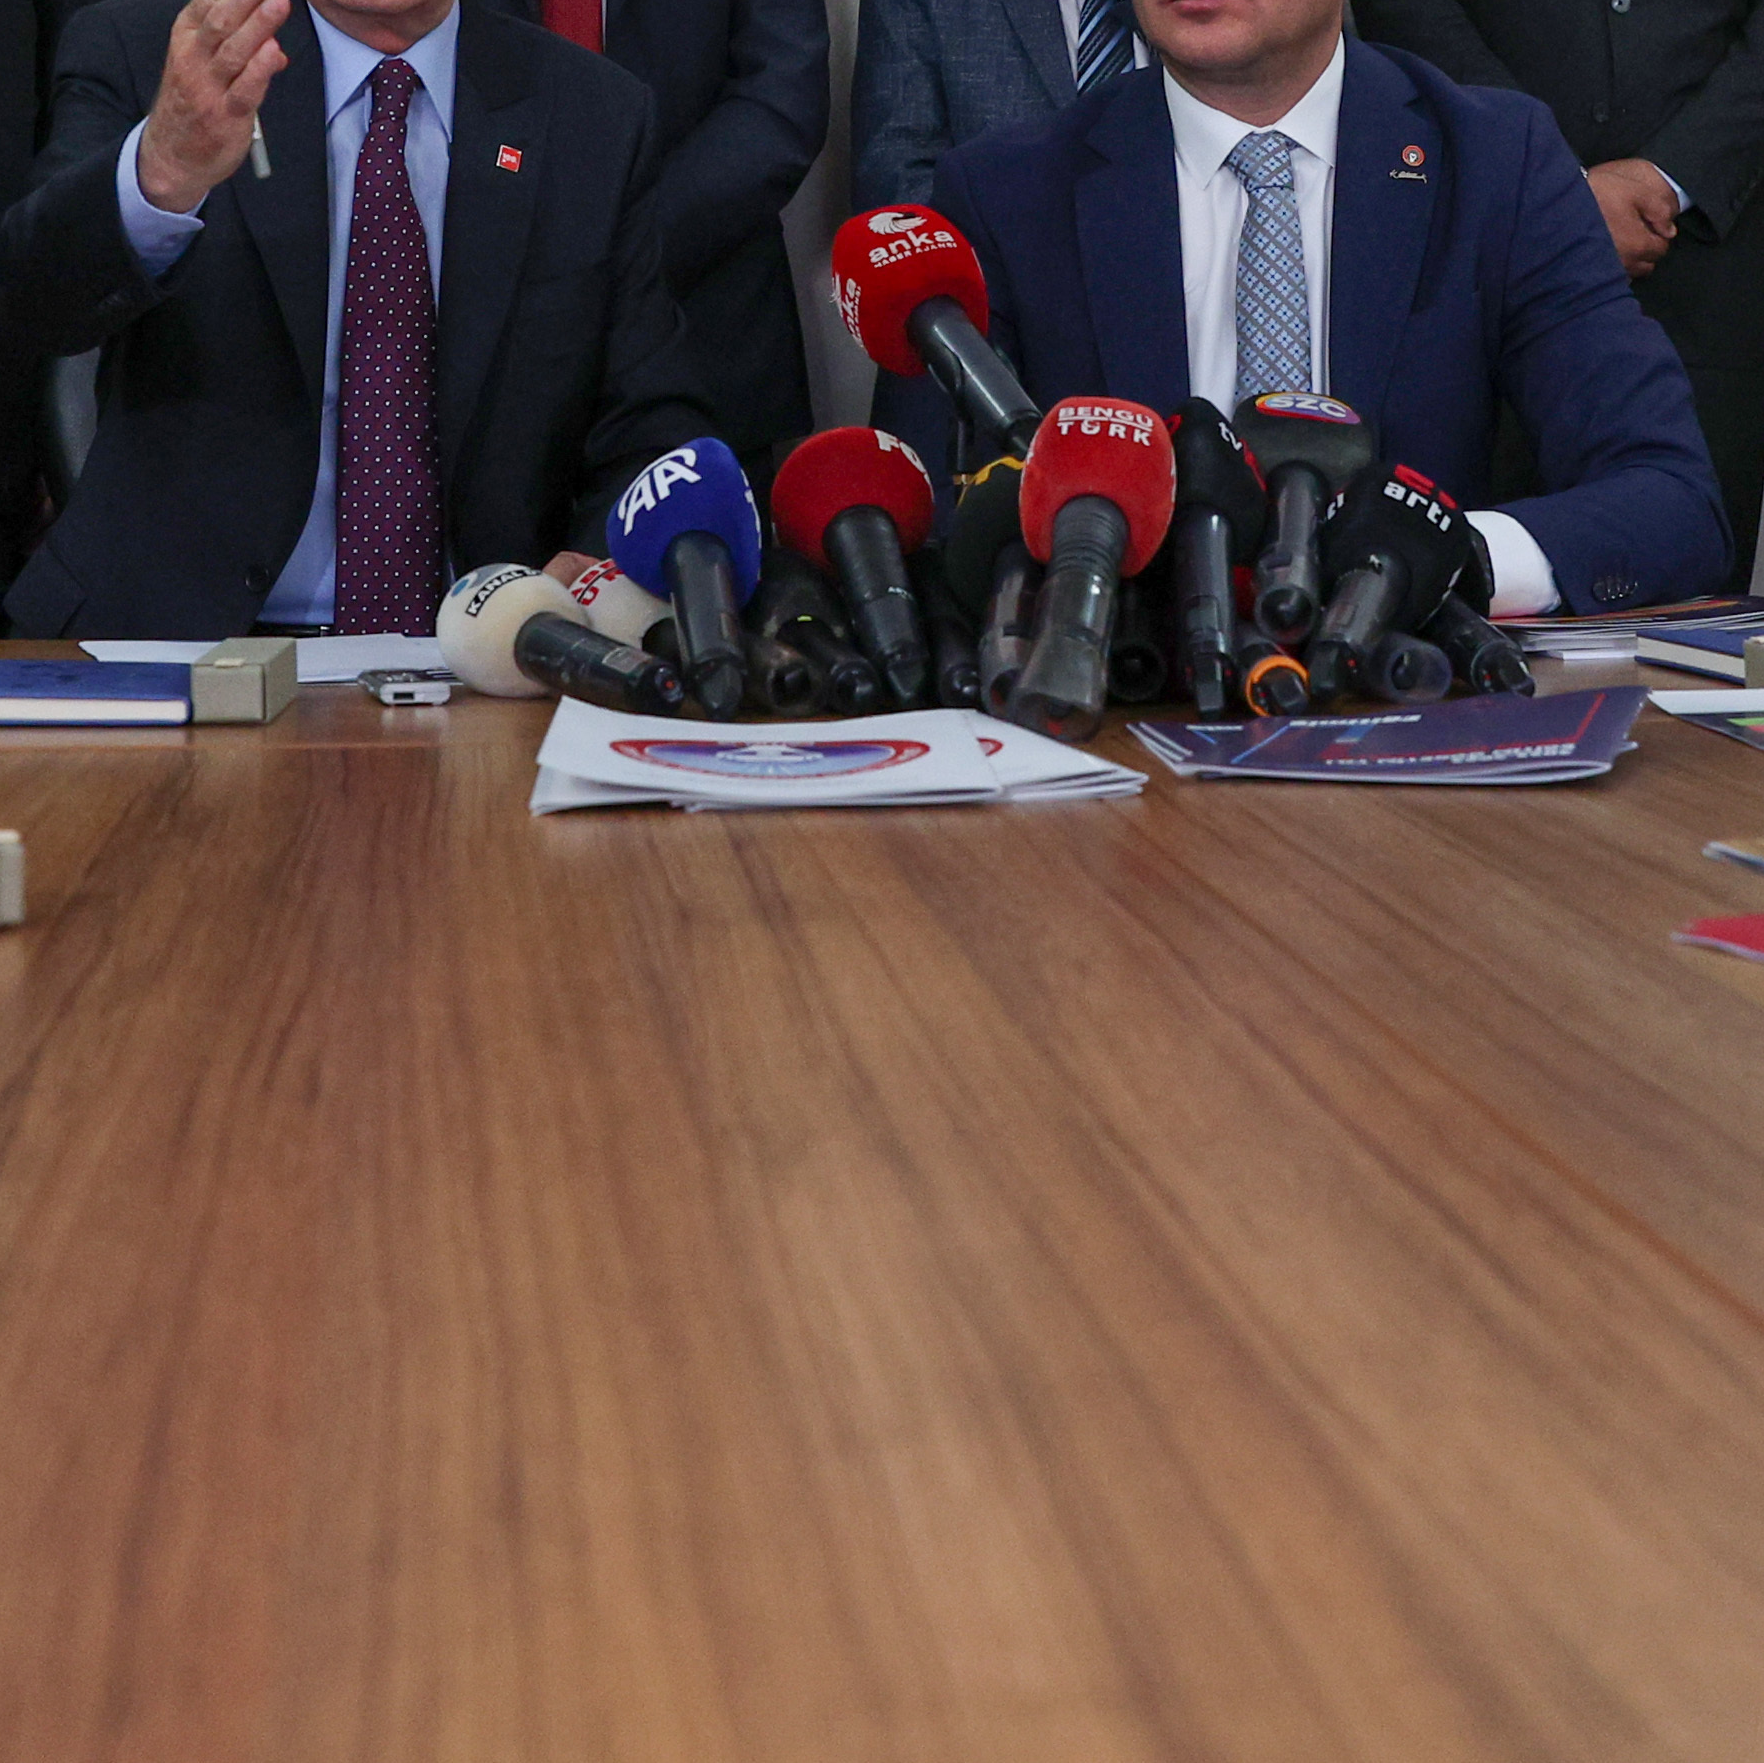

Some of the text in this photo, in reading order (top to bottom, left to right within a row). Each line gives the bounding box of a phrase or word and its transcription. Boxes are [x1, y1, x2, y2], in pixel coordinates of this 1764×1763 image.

[868, 230, 955, 264] anka
[1271, 396, 1347, 419] SZC
[617, 446, 702, 537] AA
[467, 571, 525, 616] KANAL
